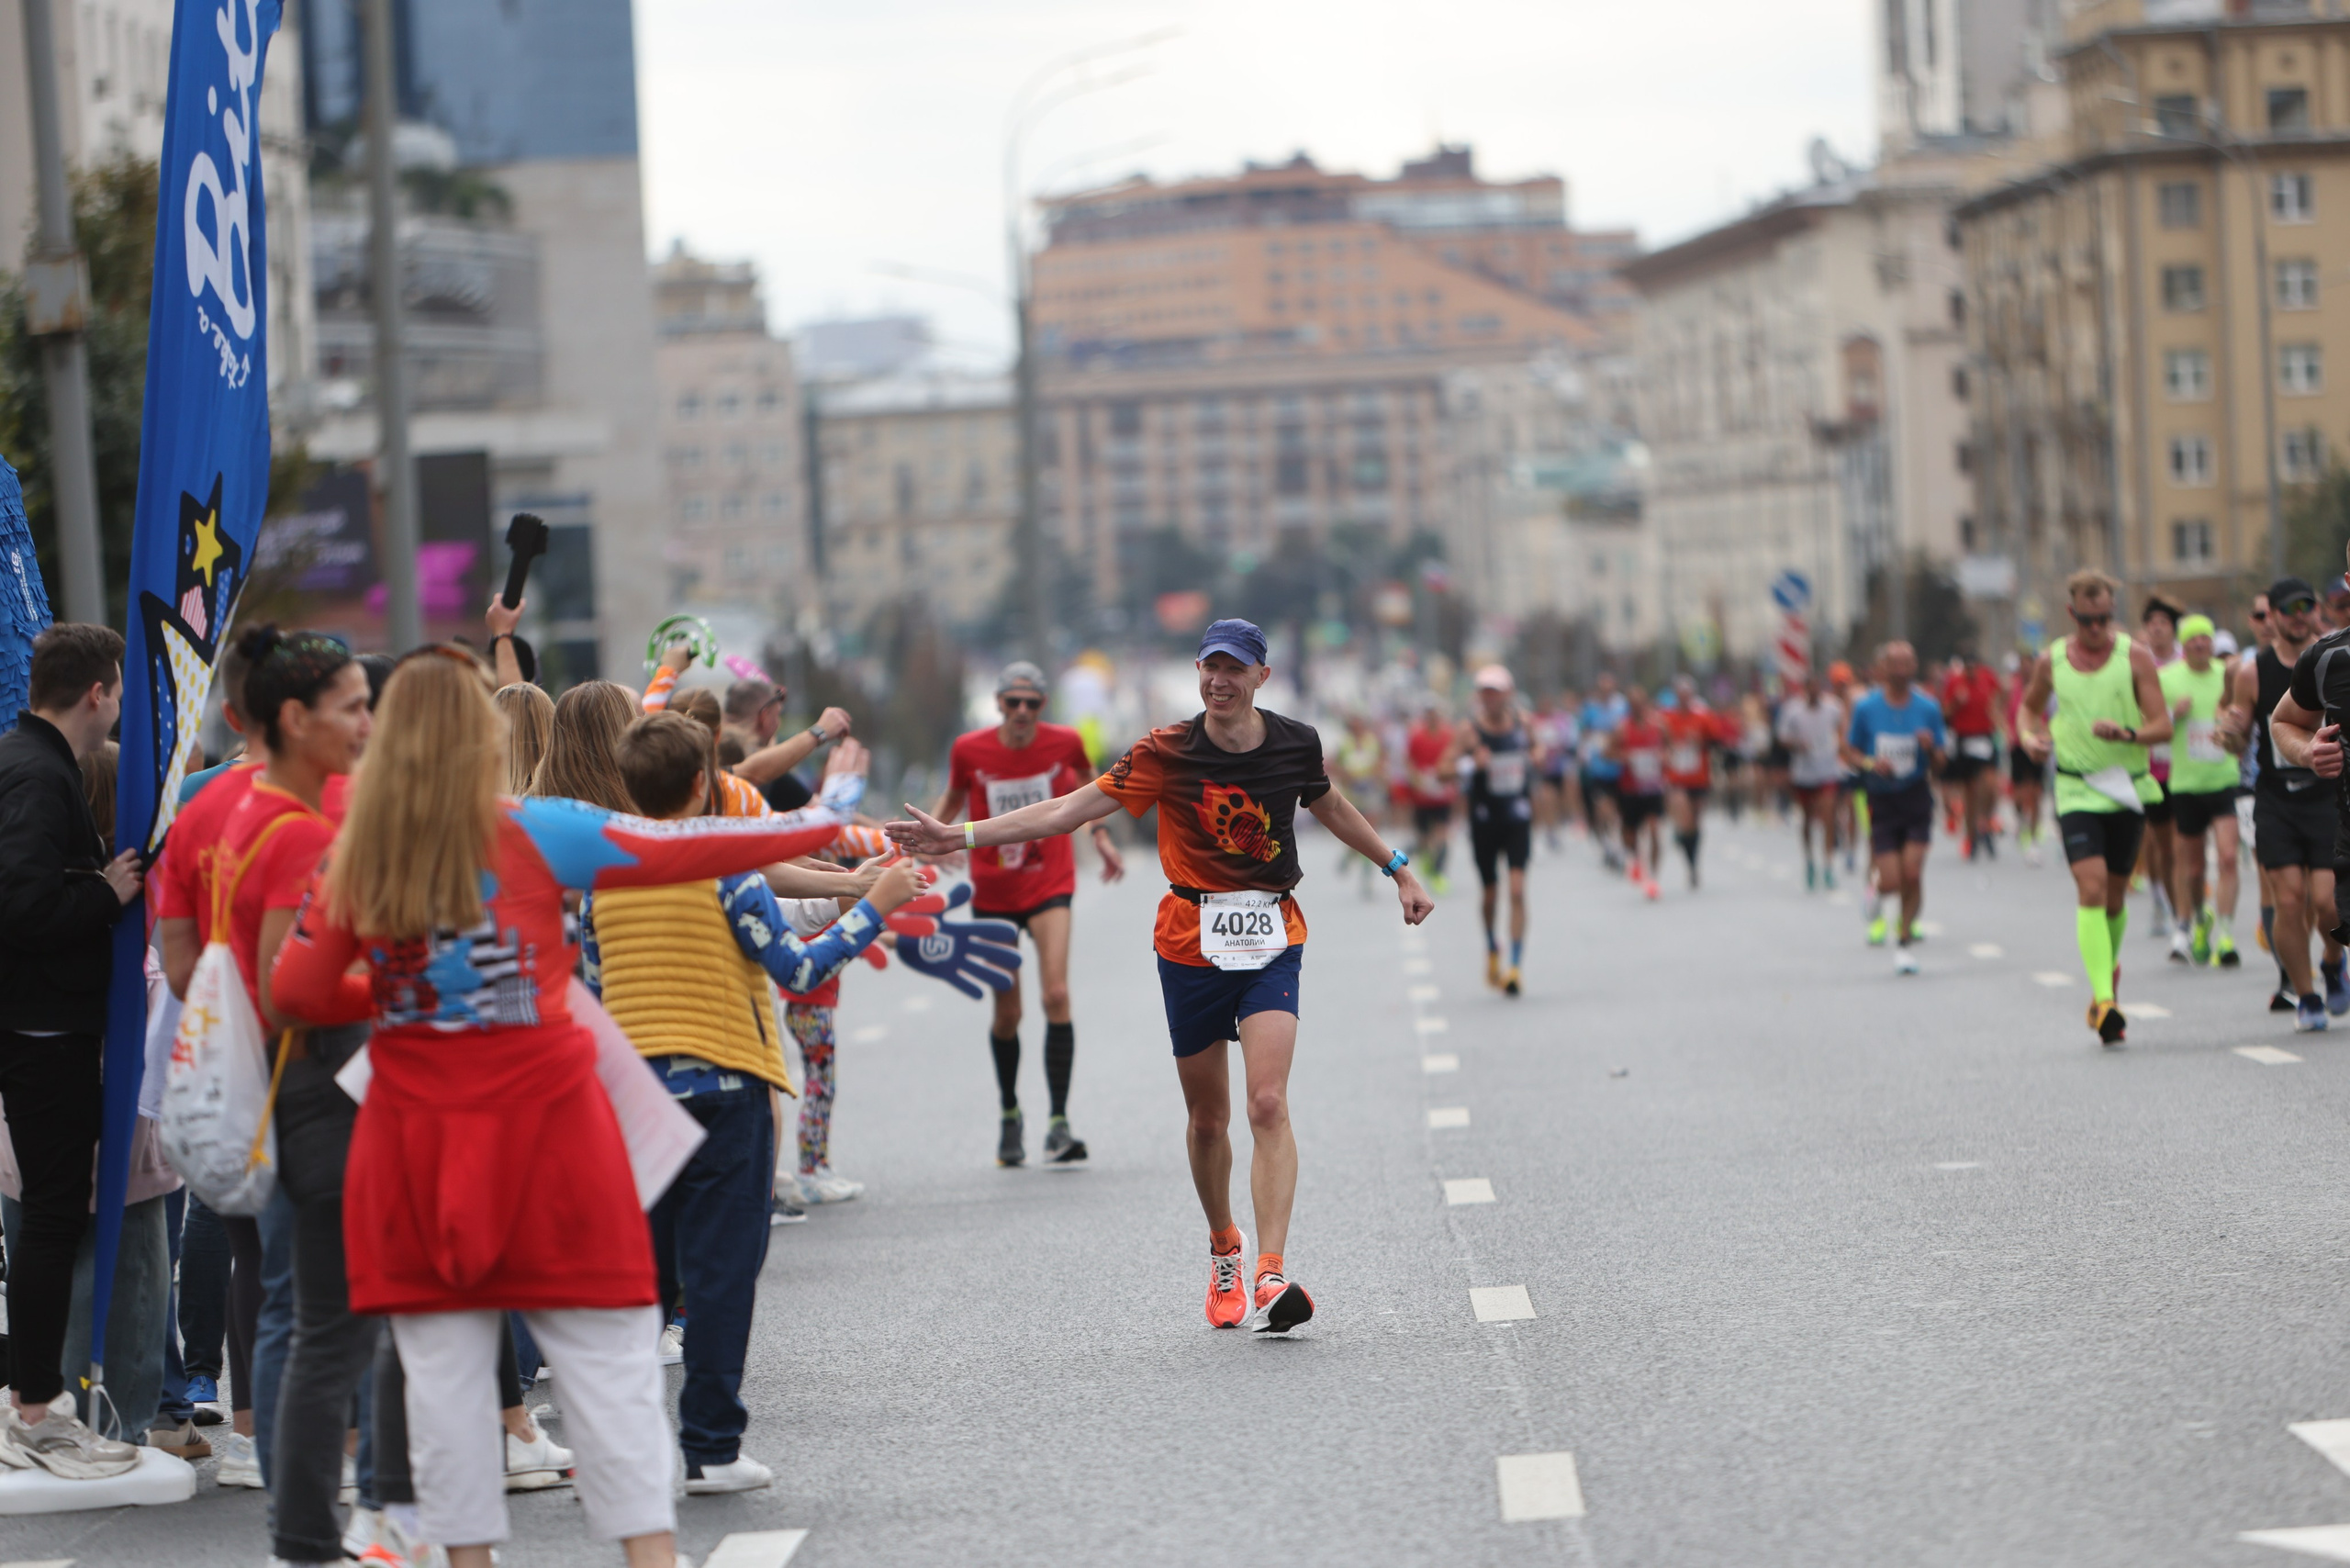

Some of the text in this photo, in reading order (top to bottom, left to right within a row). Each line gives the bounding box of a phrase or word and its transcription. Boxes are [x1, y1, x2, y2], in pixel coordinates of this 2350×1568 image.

[196, 305, 240, 389] take a
[1245, 899, 1262, 908] 42,2
[1211, 912, 1274, 936] 4028
[1224, 937, 1266, 946] АНАТОЛИЙ
